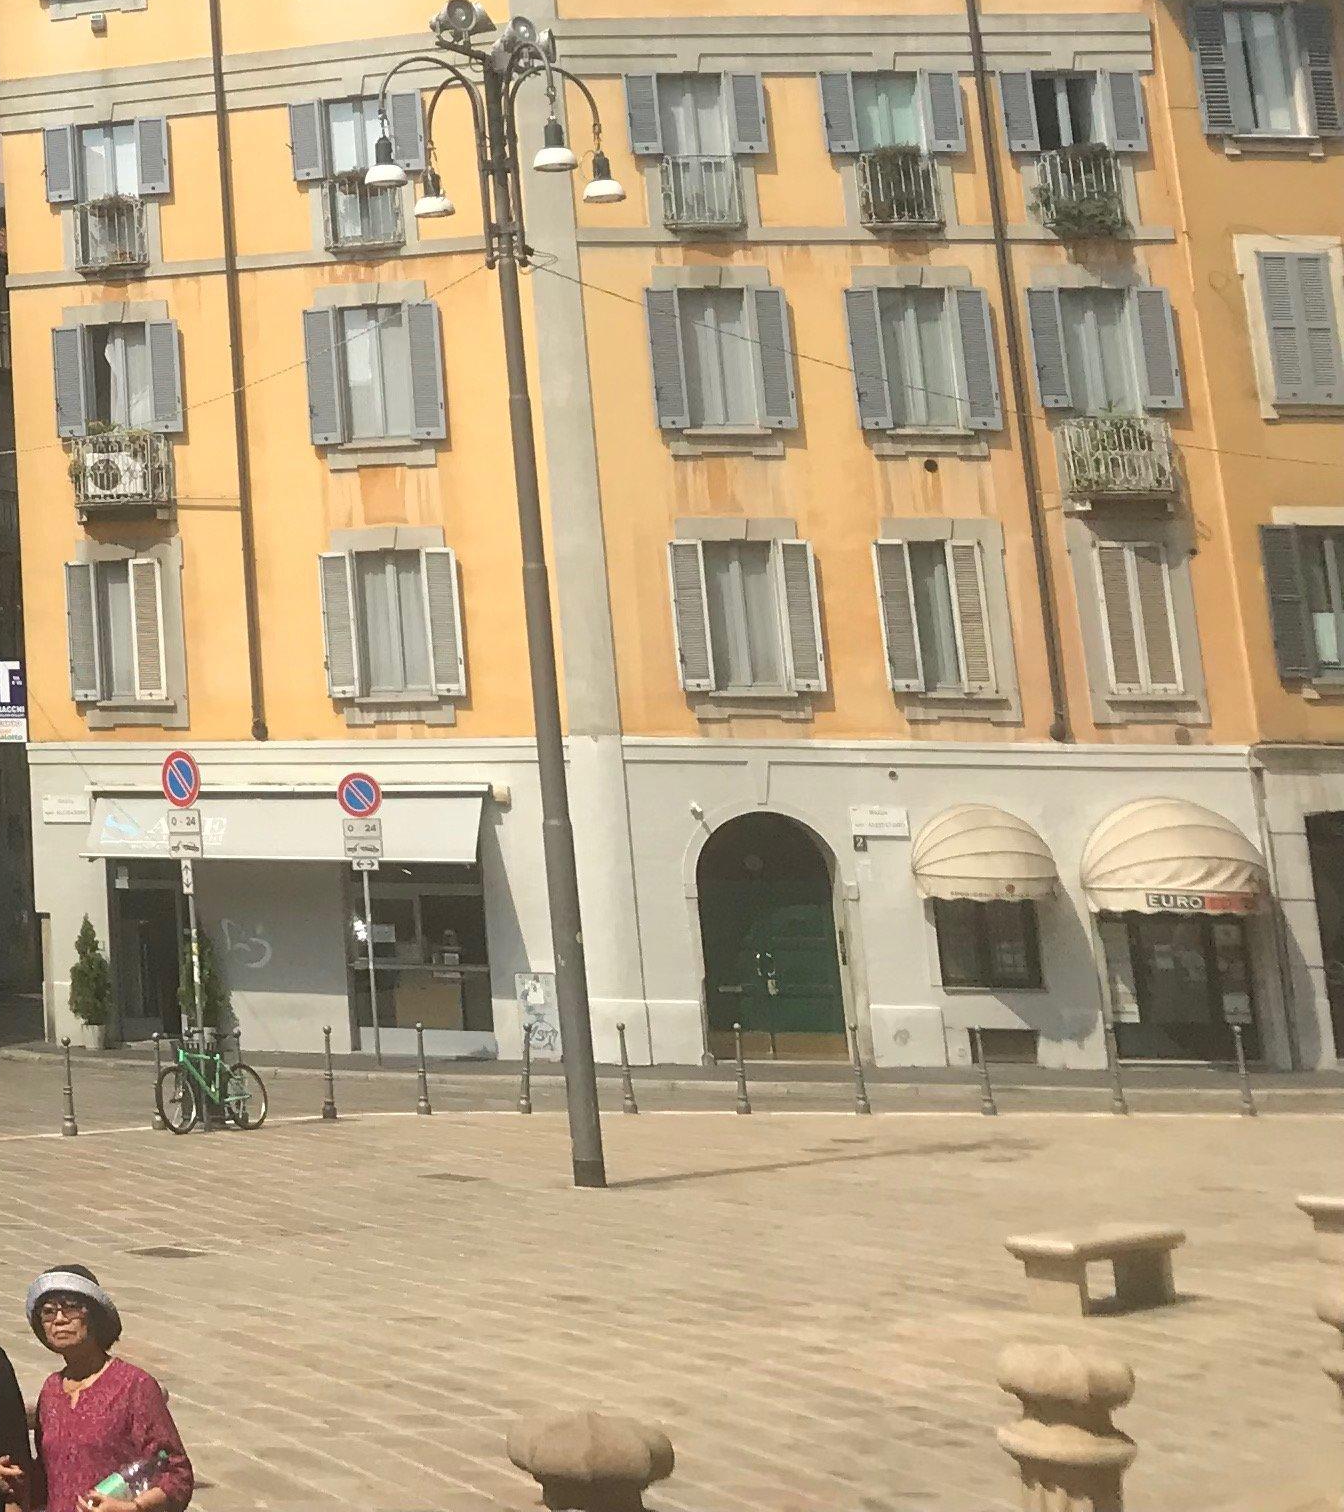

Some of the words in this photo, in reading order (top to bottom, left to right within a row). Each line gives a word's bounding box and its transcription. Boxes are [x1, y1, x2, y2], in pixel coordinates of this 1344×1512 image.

[185, 816, 197, 826] 24
[364, 824, 377, 832] 24
[1148, 894, 1203, 909] EURO
